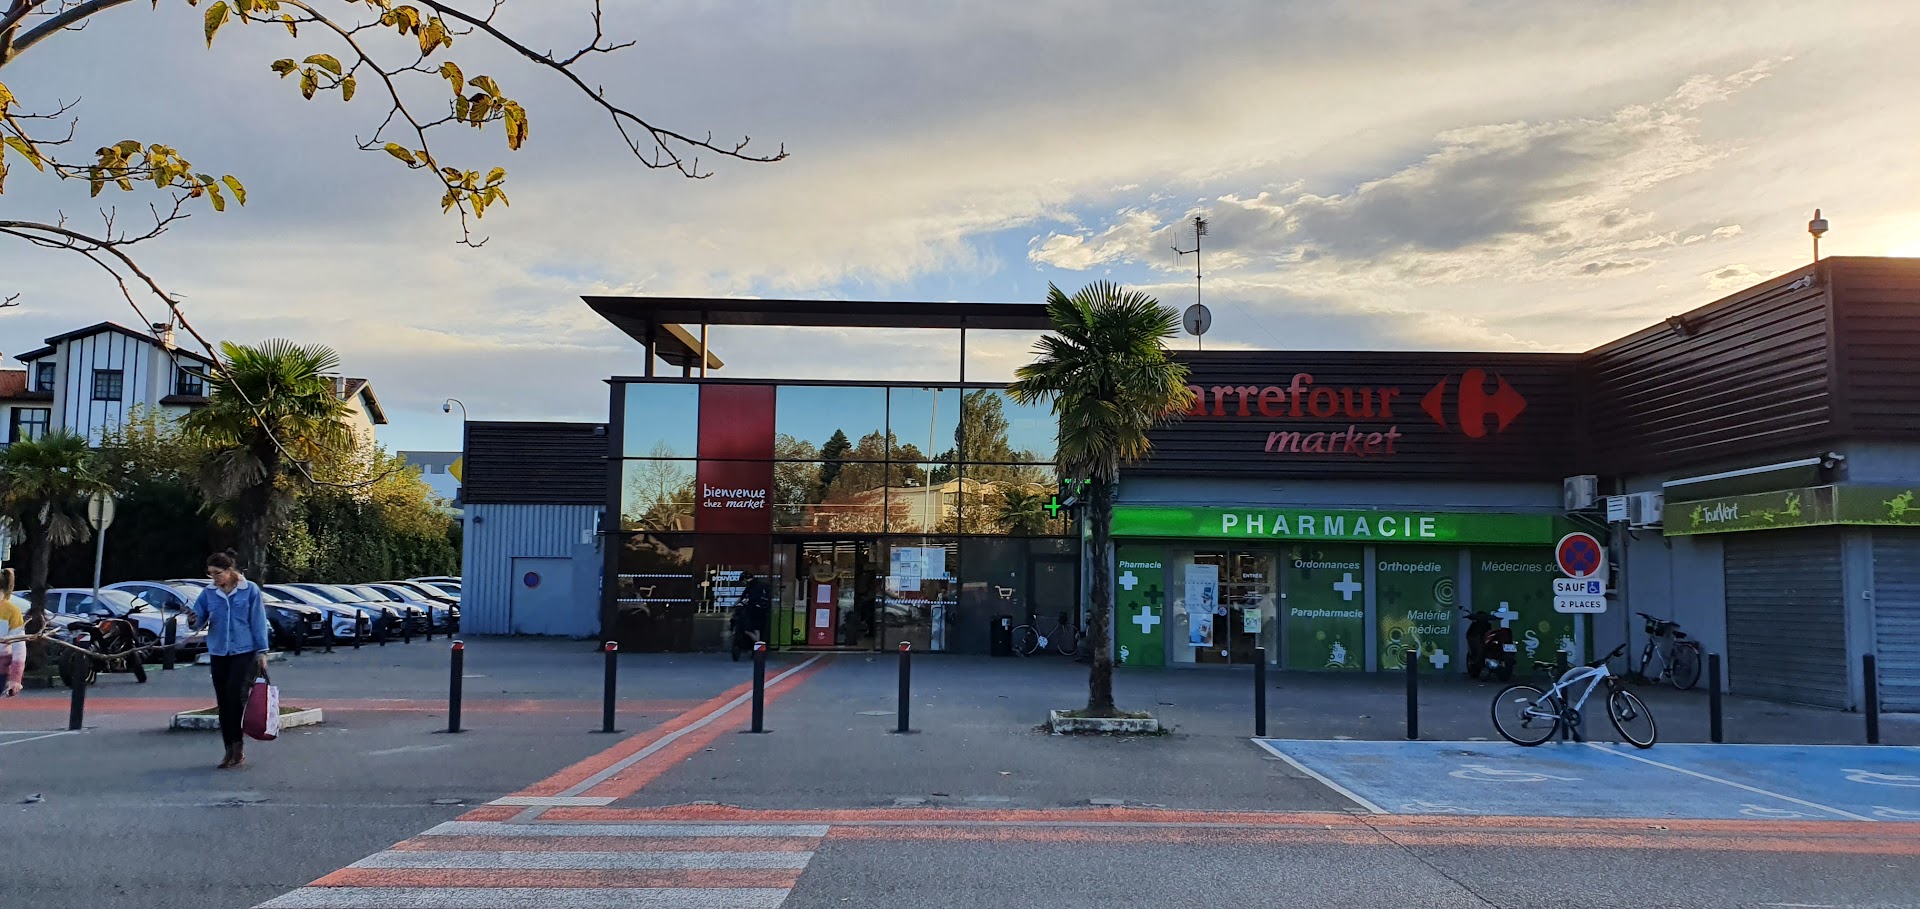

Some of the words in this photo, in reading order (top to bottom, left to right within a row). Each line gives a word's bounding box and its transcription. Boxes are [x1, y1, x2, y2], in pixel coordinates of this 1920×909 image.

[1174, 372, 1402, 419] arrefour
[1264, 425, 1402, 458] market
[703, 483, 766, 499] bienvenue
[703, 499, 722, 508] chez
[725, 499, 766, 509] market
[1221, 513, 1437, 538] PHARMACIE
[1119, 561, 1162, 569] Pharmacie
[1294, 559, 1361, 570] Ordonnances
[1378, 561, 1441, 573] Orthopédie
[1481, 561, 1542, 573] Médecines
[1557, 583, 1586, 592] SAUF
[1291, 608, 1364, 618] Parapharmacie
[1407, 609, 1451, 621] Matériel
[1407, 624, 1451, 635] médical
